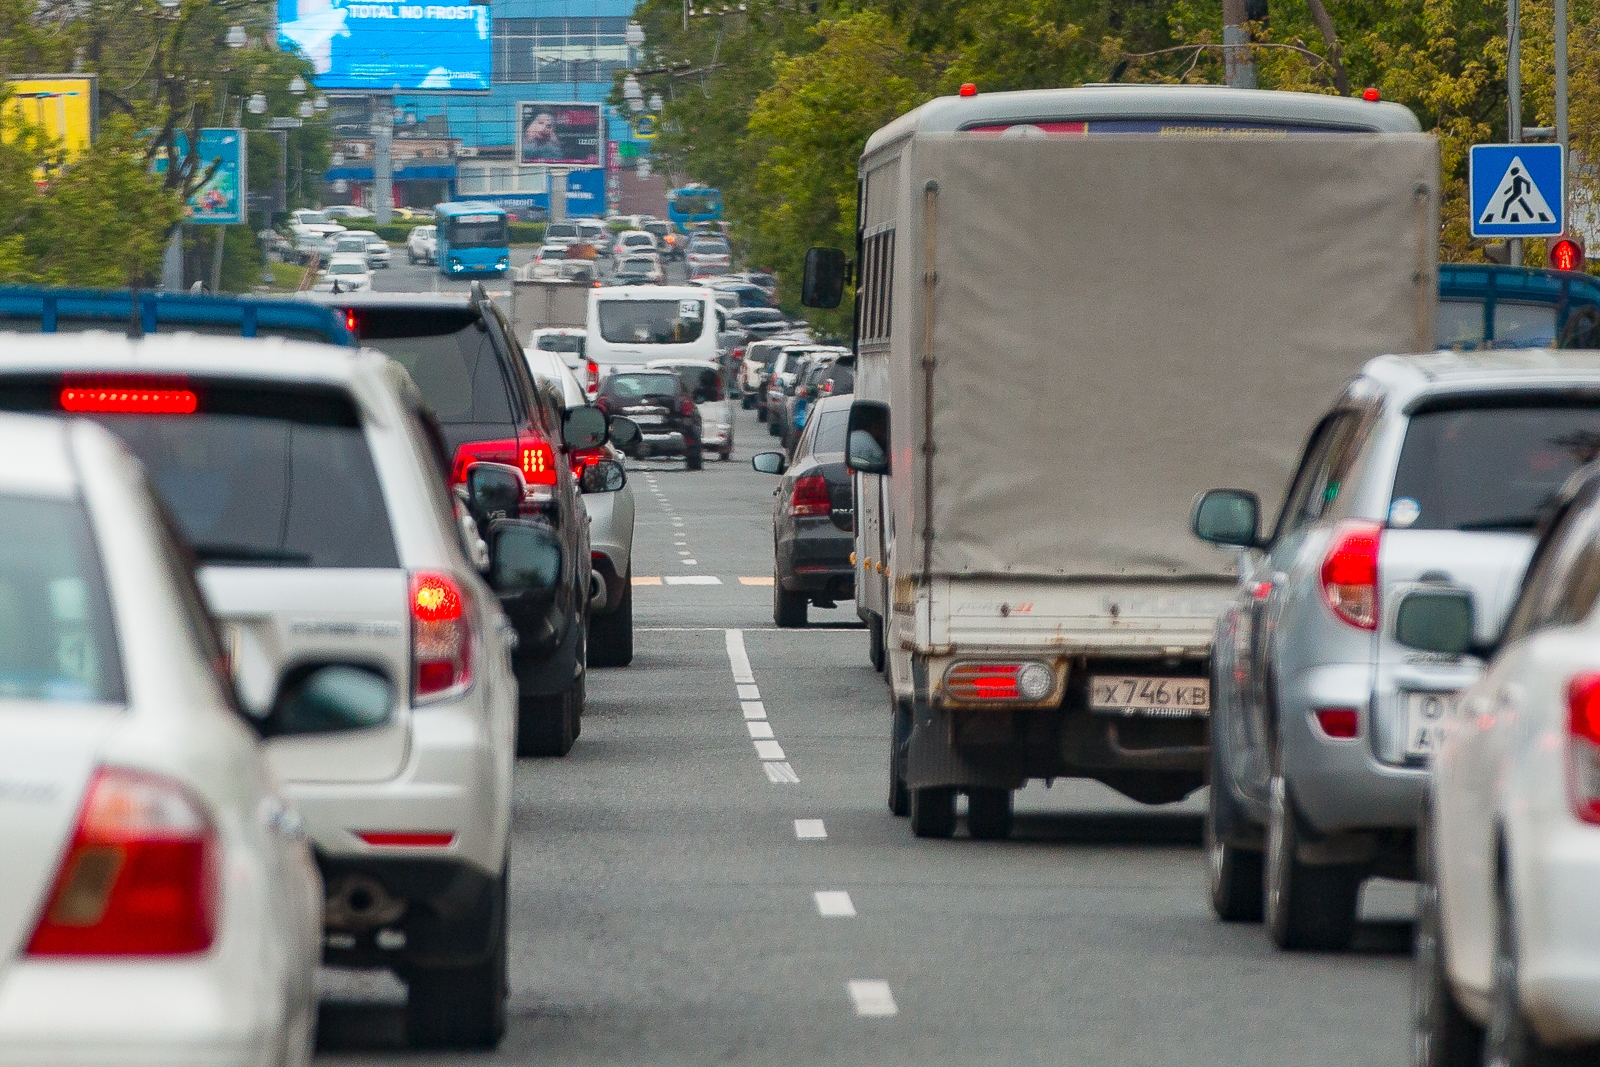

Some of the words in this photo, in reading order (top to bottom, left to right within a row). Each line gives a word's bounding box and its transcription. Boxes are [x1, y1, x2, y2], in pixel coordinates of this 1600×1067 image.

[348, 5, 397, 18] TOTAL
[399, 6, 422, 19] NO
[425, 6, 476, 19] FROST
